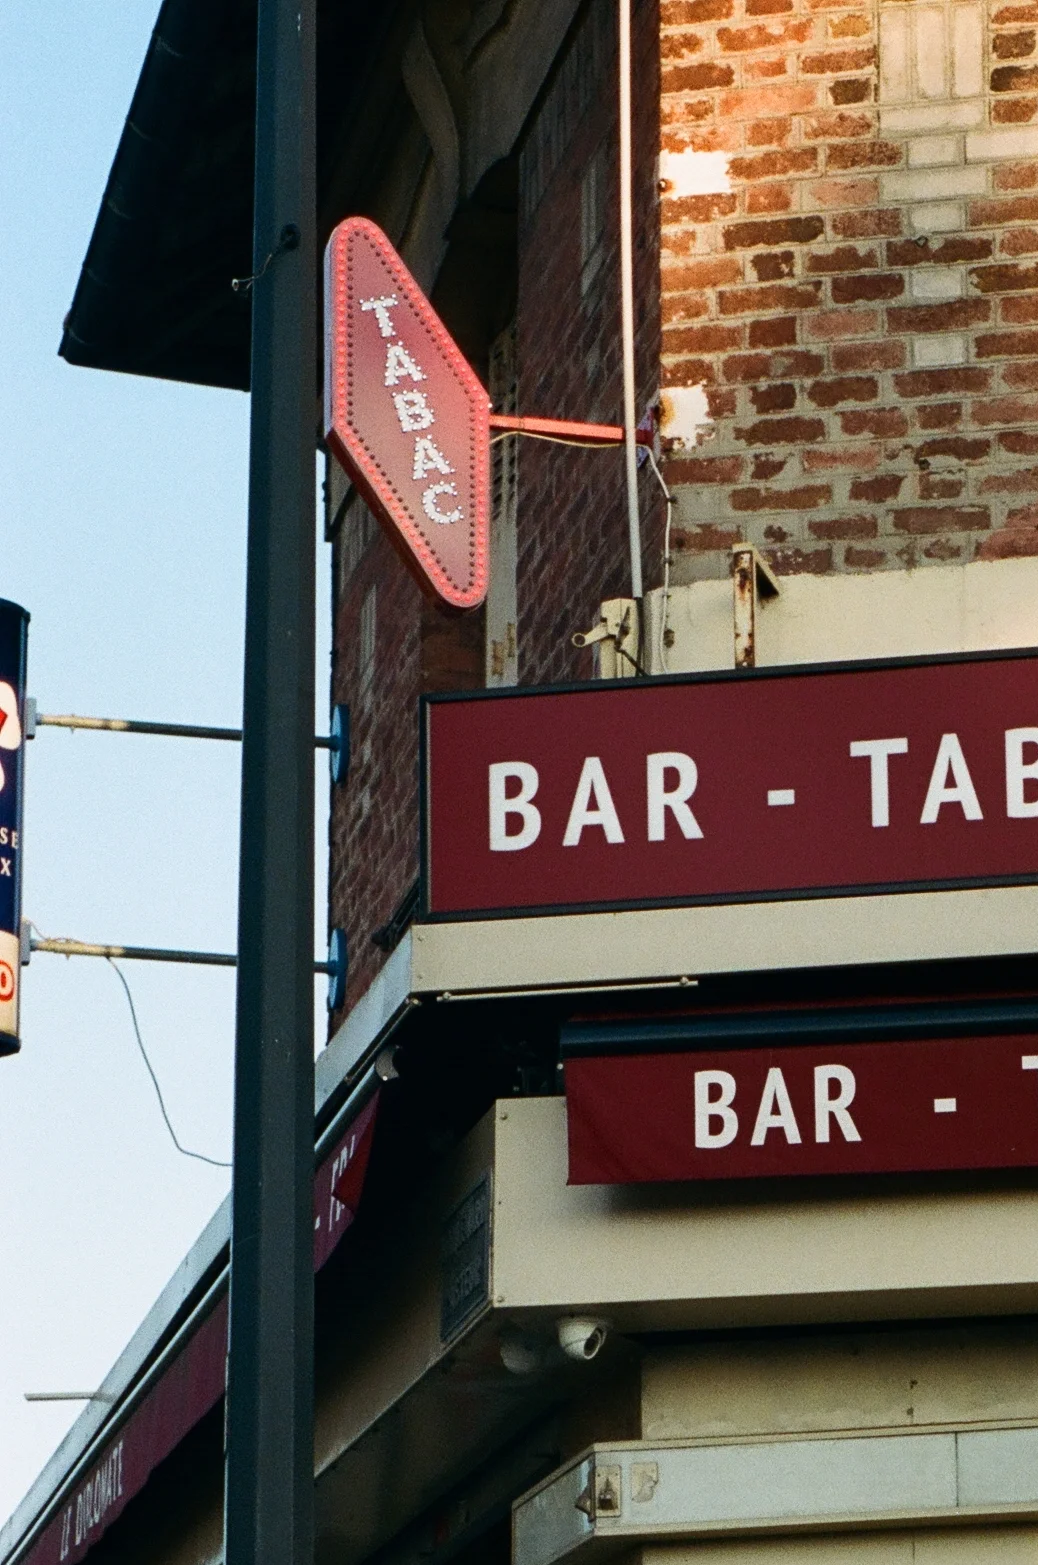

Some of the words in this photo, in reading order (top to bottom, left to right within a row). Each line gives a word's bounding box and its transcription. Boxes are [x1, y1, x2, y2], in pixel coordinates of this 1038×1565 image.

[360, 294, 464, 524] TABAC
[488, 751, 705, 852] BAR
[767, 789, 795, 806] -
[693, 1062, 863, 1150] BAR
[933, 1096, 957, 1113] -
